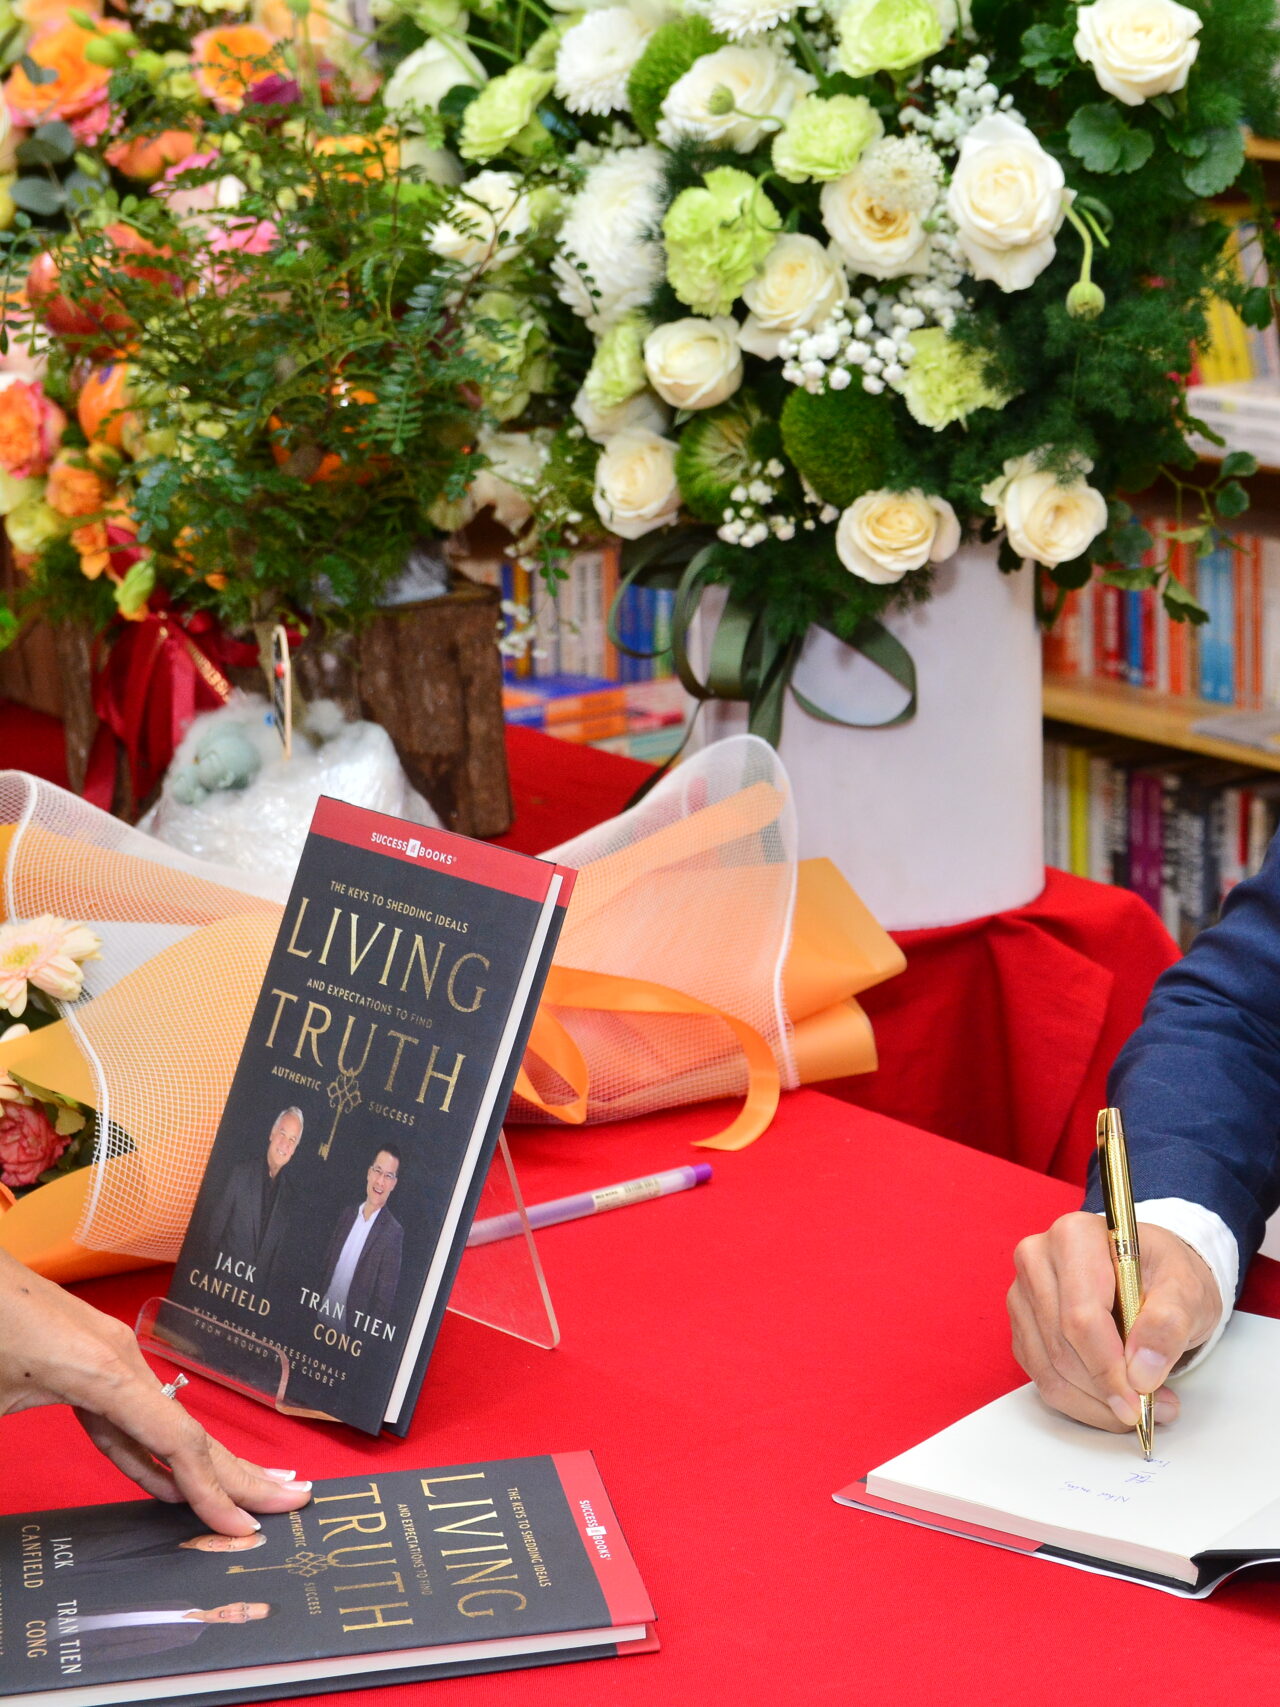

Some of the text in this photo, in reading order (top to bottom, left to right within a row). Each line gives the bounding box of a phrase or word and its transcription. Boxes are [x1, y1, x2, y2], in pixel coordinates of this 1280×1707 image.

[371, 832, 408, 851] SUCCESS
[330, 880, 469, 933] THE KEYS TO SHEDDING IDEALS
[286, 897, 491, 1013] LIVING
[306, 978, 433, 1029] AND EXPECTATIONS TO FIND
[265, 988, 466, 1113] TRUTH
[271, 1065, 415, 1126] AUTHENTIC SUCCESS
[189, 1268, 271, 1317] CANFIELD
[214, 1251, 257, 1284] JACK
[192, 1305, 347, 1381] WITH OTHER PROFESSIONALS
[300, 1287, 397, 1343] TRAN TIEN
[313, 1323, 364, 1357] CONG
[194, 1318, 335, 1388] FROM AROUND TE GLOBE
[420, 1472, 527, 1618] LIVING
[507, 1487, 551, 1588] THE KEYS TO SHEDDING IDEALS
[579, 1499, 599, 1528] SUCCESS
[21, 1524, 44, 1589] CANFIELD
[50, 1537, 75, 1569] JACK
[289, 1511, 322, 1615] AUTHENTIC SUCCESS
[313, 1482, 414, 1633] TRUTH
[397, 1503, 433, 1596] AND EXPECTATIONS TO FIND
[25, 1620, 48, 1659] CONG
[57, 1599, 82, 1675] TRAN TIEN
